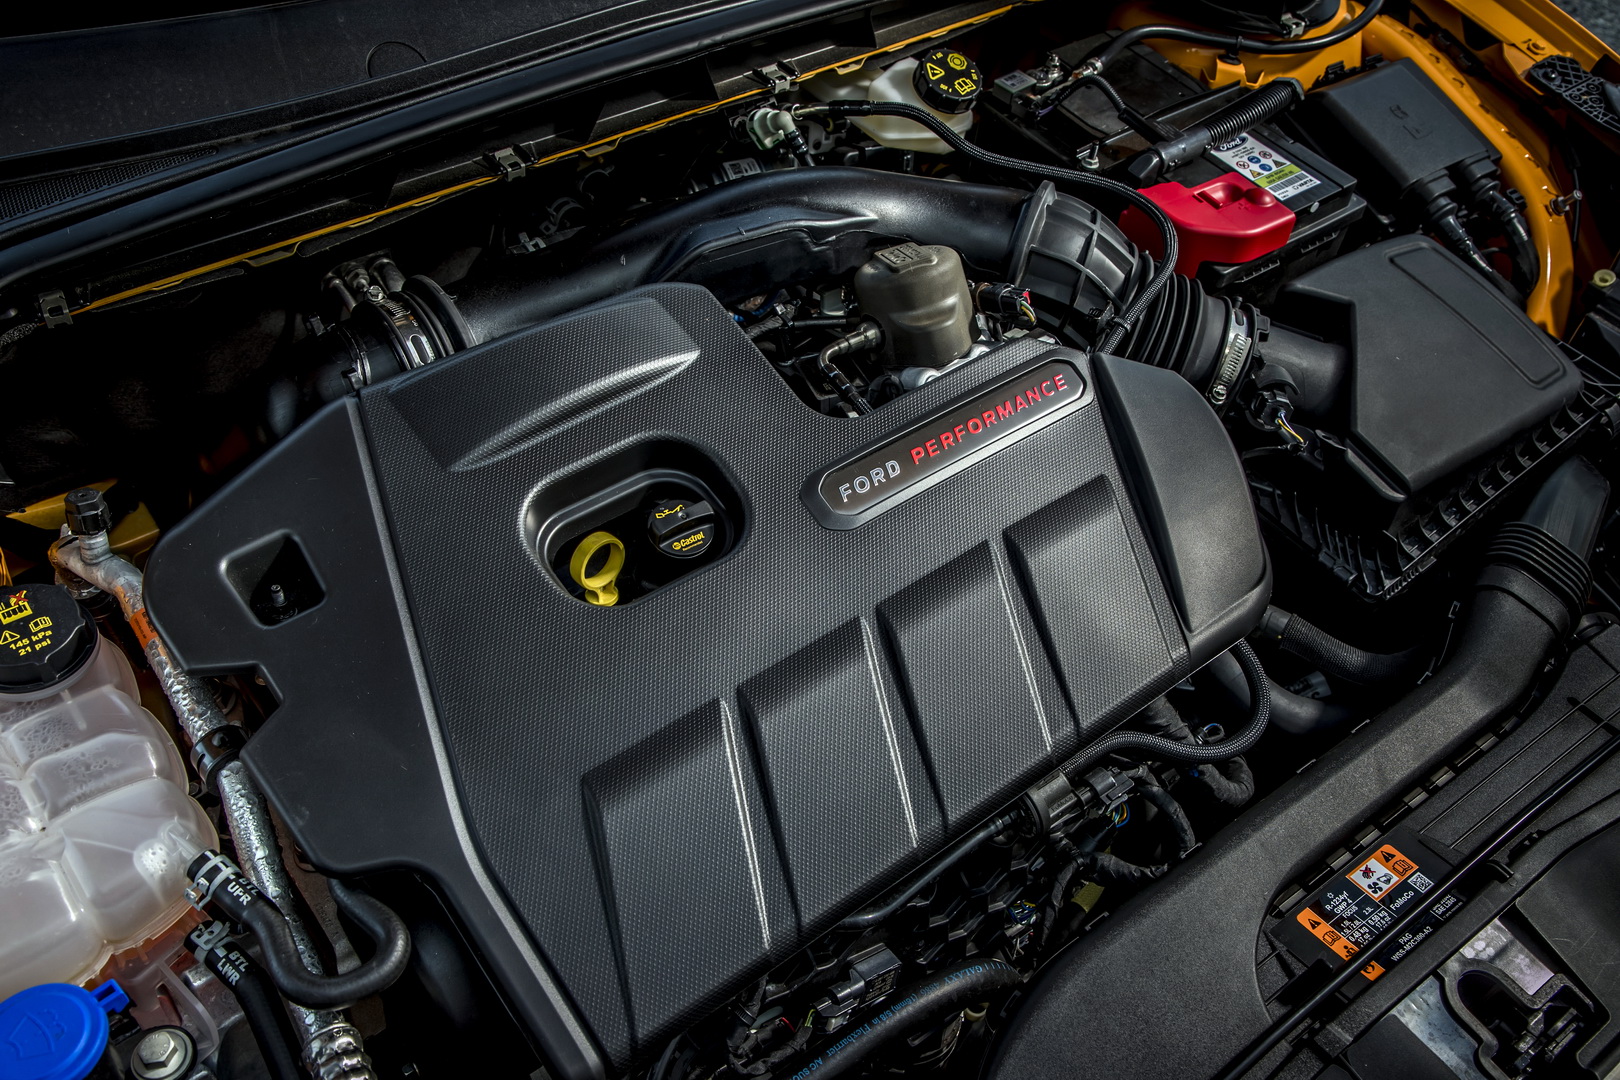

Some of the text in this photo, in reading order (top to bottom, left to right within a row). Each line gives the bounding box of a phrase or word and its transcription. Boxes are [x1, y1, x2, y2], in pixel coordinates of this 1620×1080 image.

[1219, 138, 1242, 151] Ford
[838, 373, 1069, 502] FORD PERFORMANCE
[680, 531, 705, 547] Castrol
[9, 630, 53, 650] 145 kPa
[18, 638, 52, 656] 21 psi
[239, 877, 259, 896] BTL
[1333, 901, 1347, 914] GWP
[1389, 890, 1415, 911] FoMoCo
[1342, 905, 1358, 919] FOCUS
[1377, 910, 1389, 918] kg
[1358, 926, 1370, 934] kg
[1398, 932, 1413, 945] PAG
[228, 950, 249, 972] BTL
[216, 958, 240, 986] LWR
[943, 964, 983, 986] GALAXY
[826, 1023, 872, 1057] Flexbarrier
[809, 1056, 823, 1070] A/C
